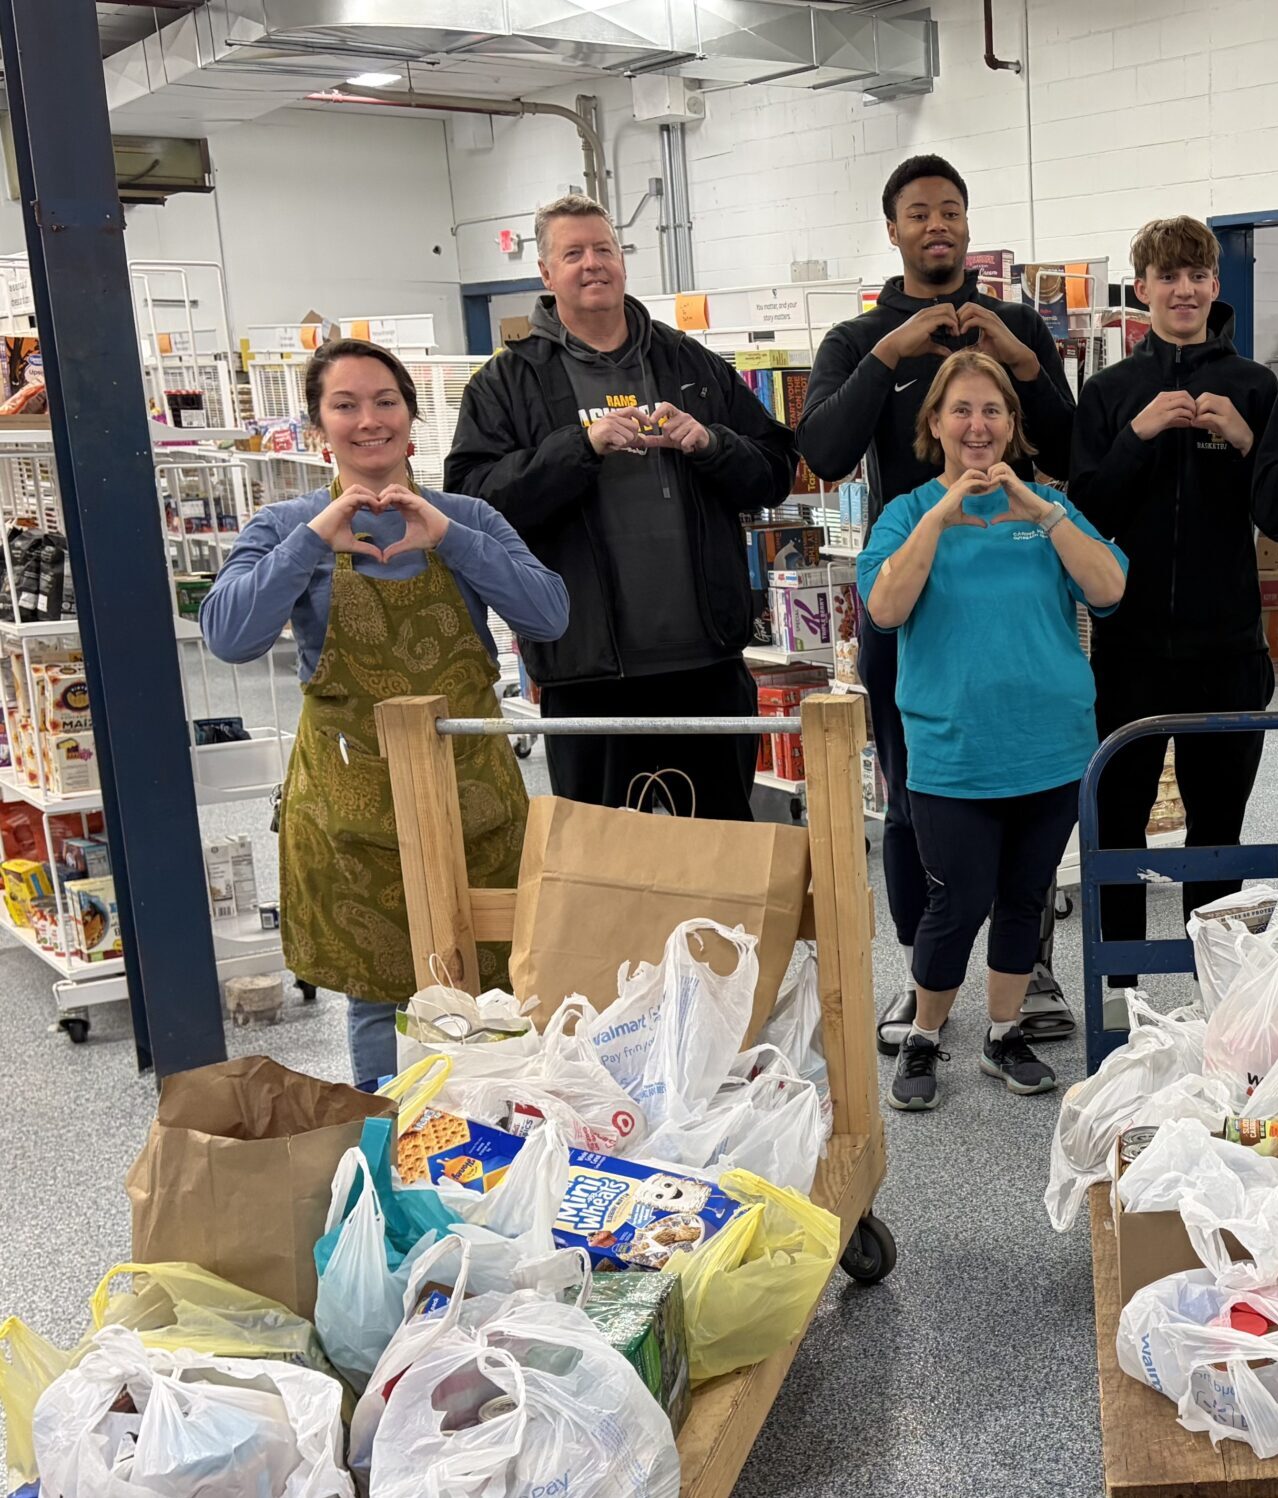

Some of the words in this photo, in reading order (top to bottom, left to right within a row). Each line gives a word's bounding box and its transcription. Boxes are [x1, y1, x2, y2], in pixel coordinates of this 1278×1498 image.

[787, 376, 795, 400] YOUR
[605, 394, 638, 407] RAMS
[819, 597, 827, 617] BERRY
[820, 618, 828, 640] TRIPLE
[600, 1051, 621, 1066] Pay
[450, 1158, 476, 1181] Honey
[556, 1175, 599, 1223] Mini
[577, 1178, 629, 1230] Wheats
